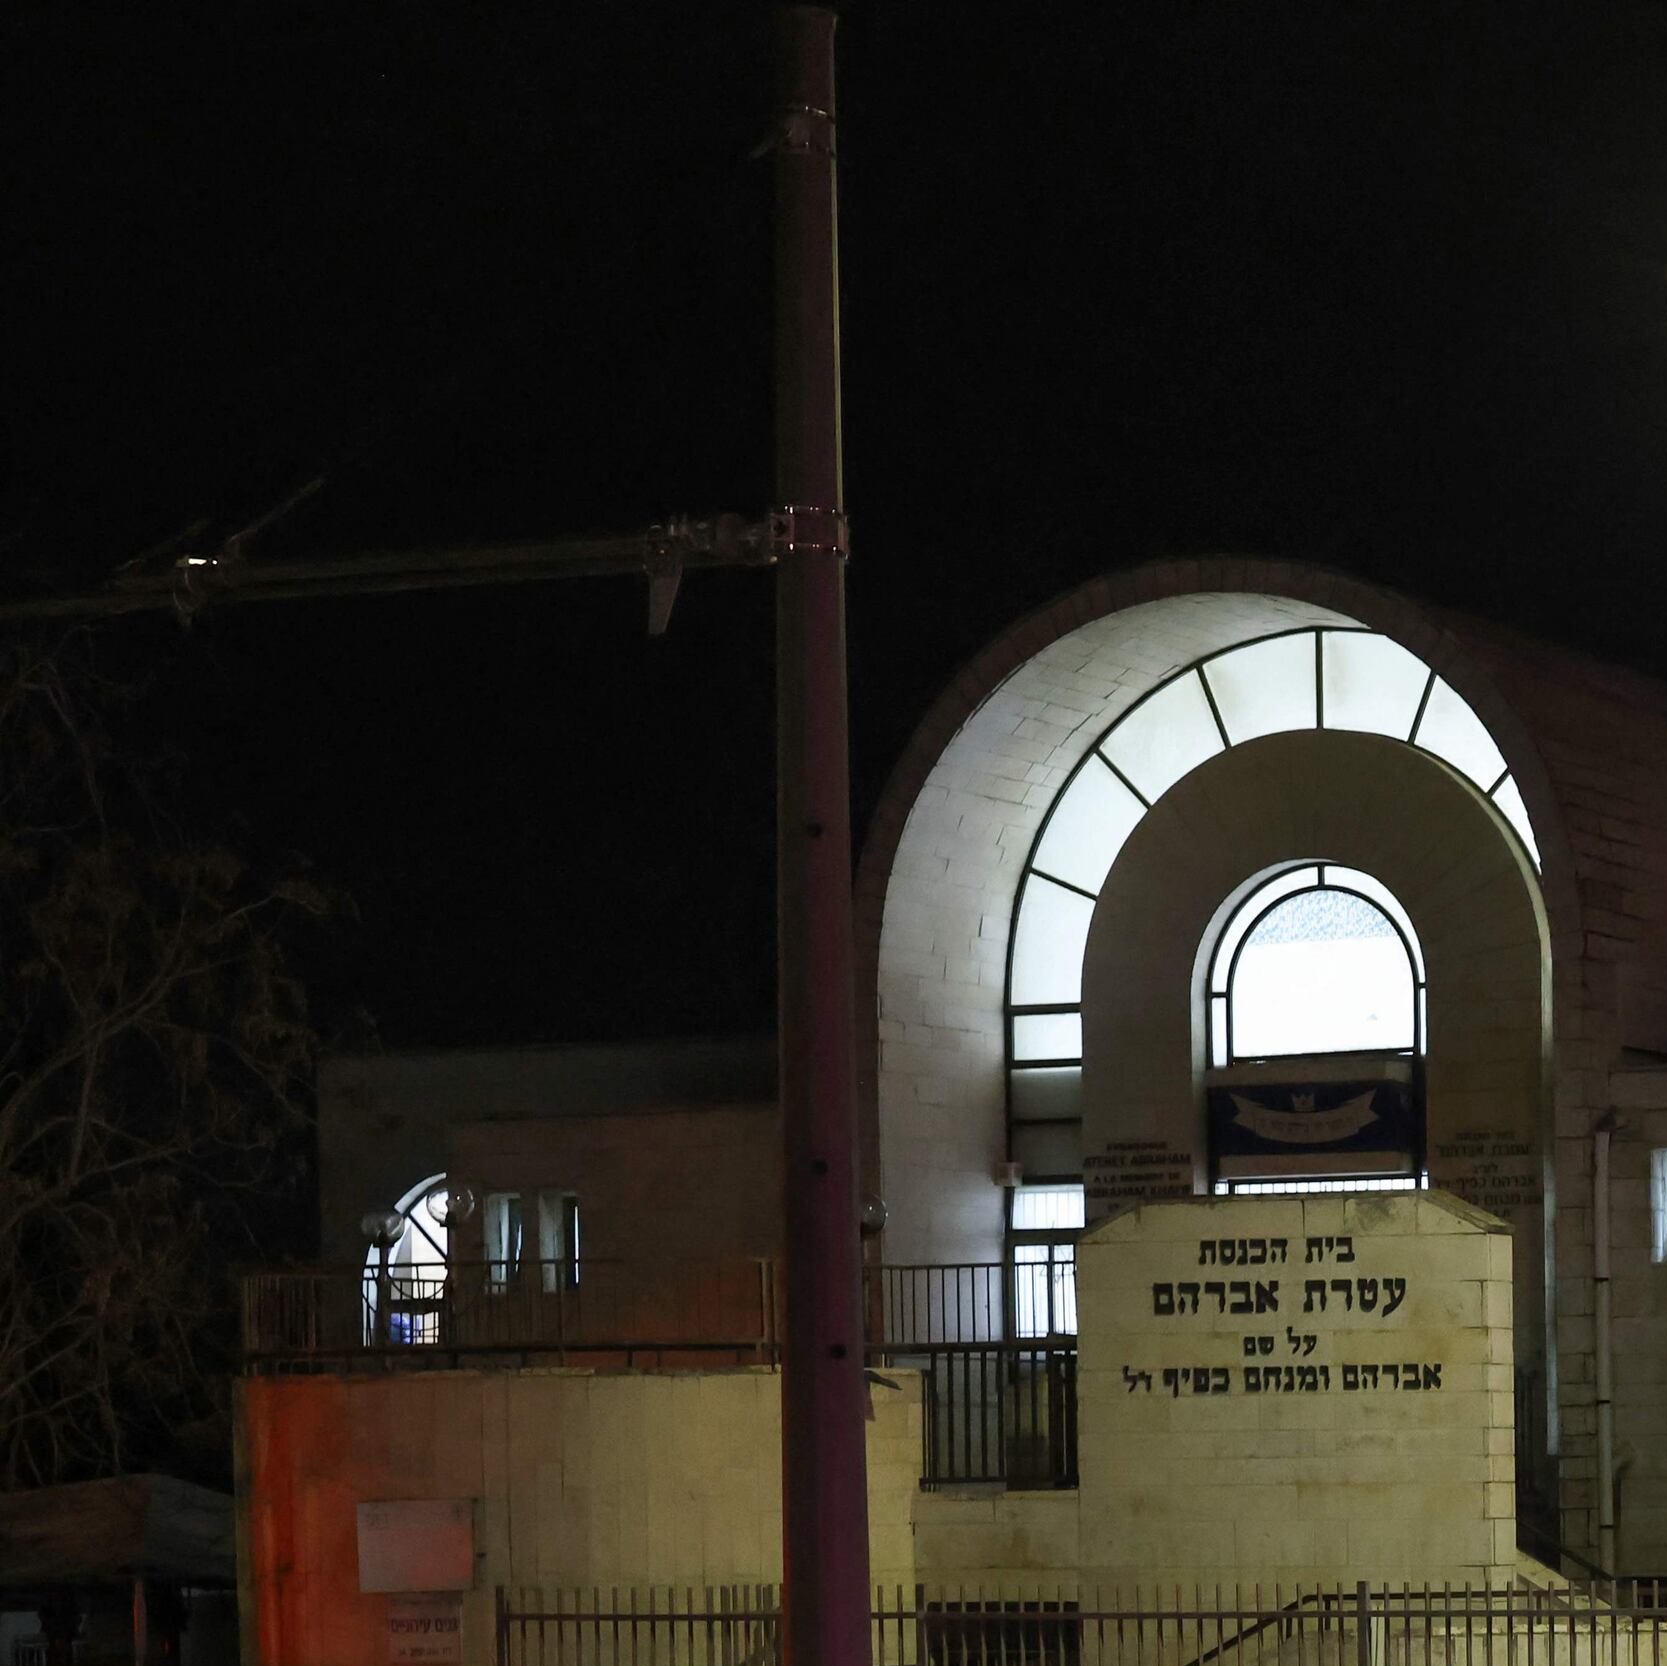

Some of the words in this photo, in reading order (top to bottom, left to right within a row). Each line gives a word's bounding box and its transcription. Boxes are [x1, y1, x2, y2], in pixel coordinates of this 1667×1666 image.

[1198, 1238, 1288, 1265] הכנסת
[1304, 1236, 1355, 1264] בית
[1152, 1279, 1279, 1316] אברהם
[1303, 1277, 1407, 1318] עטרת
[1244, 1335, 1274, 1356] שם
[1286, 1327, 1318, 1356] על
[1244, 1364, 1330, 1393] ומנחם
[1343, 1363, 1442, 1391] אברהם
